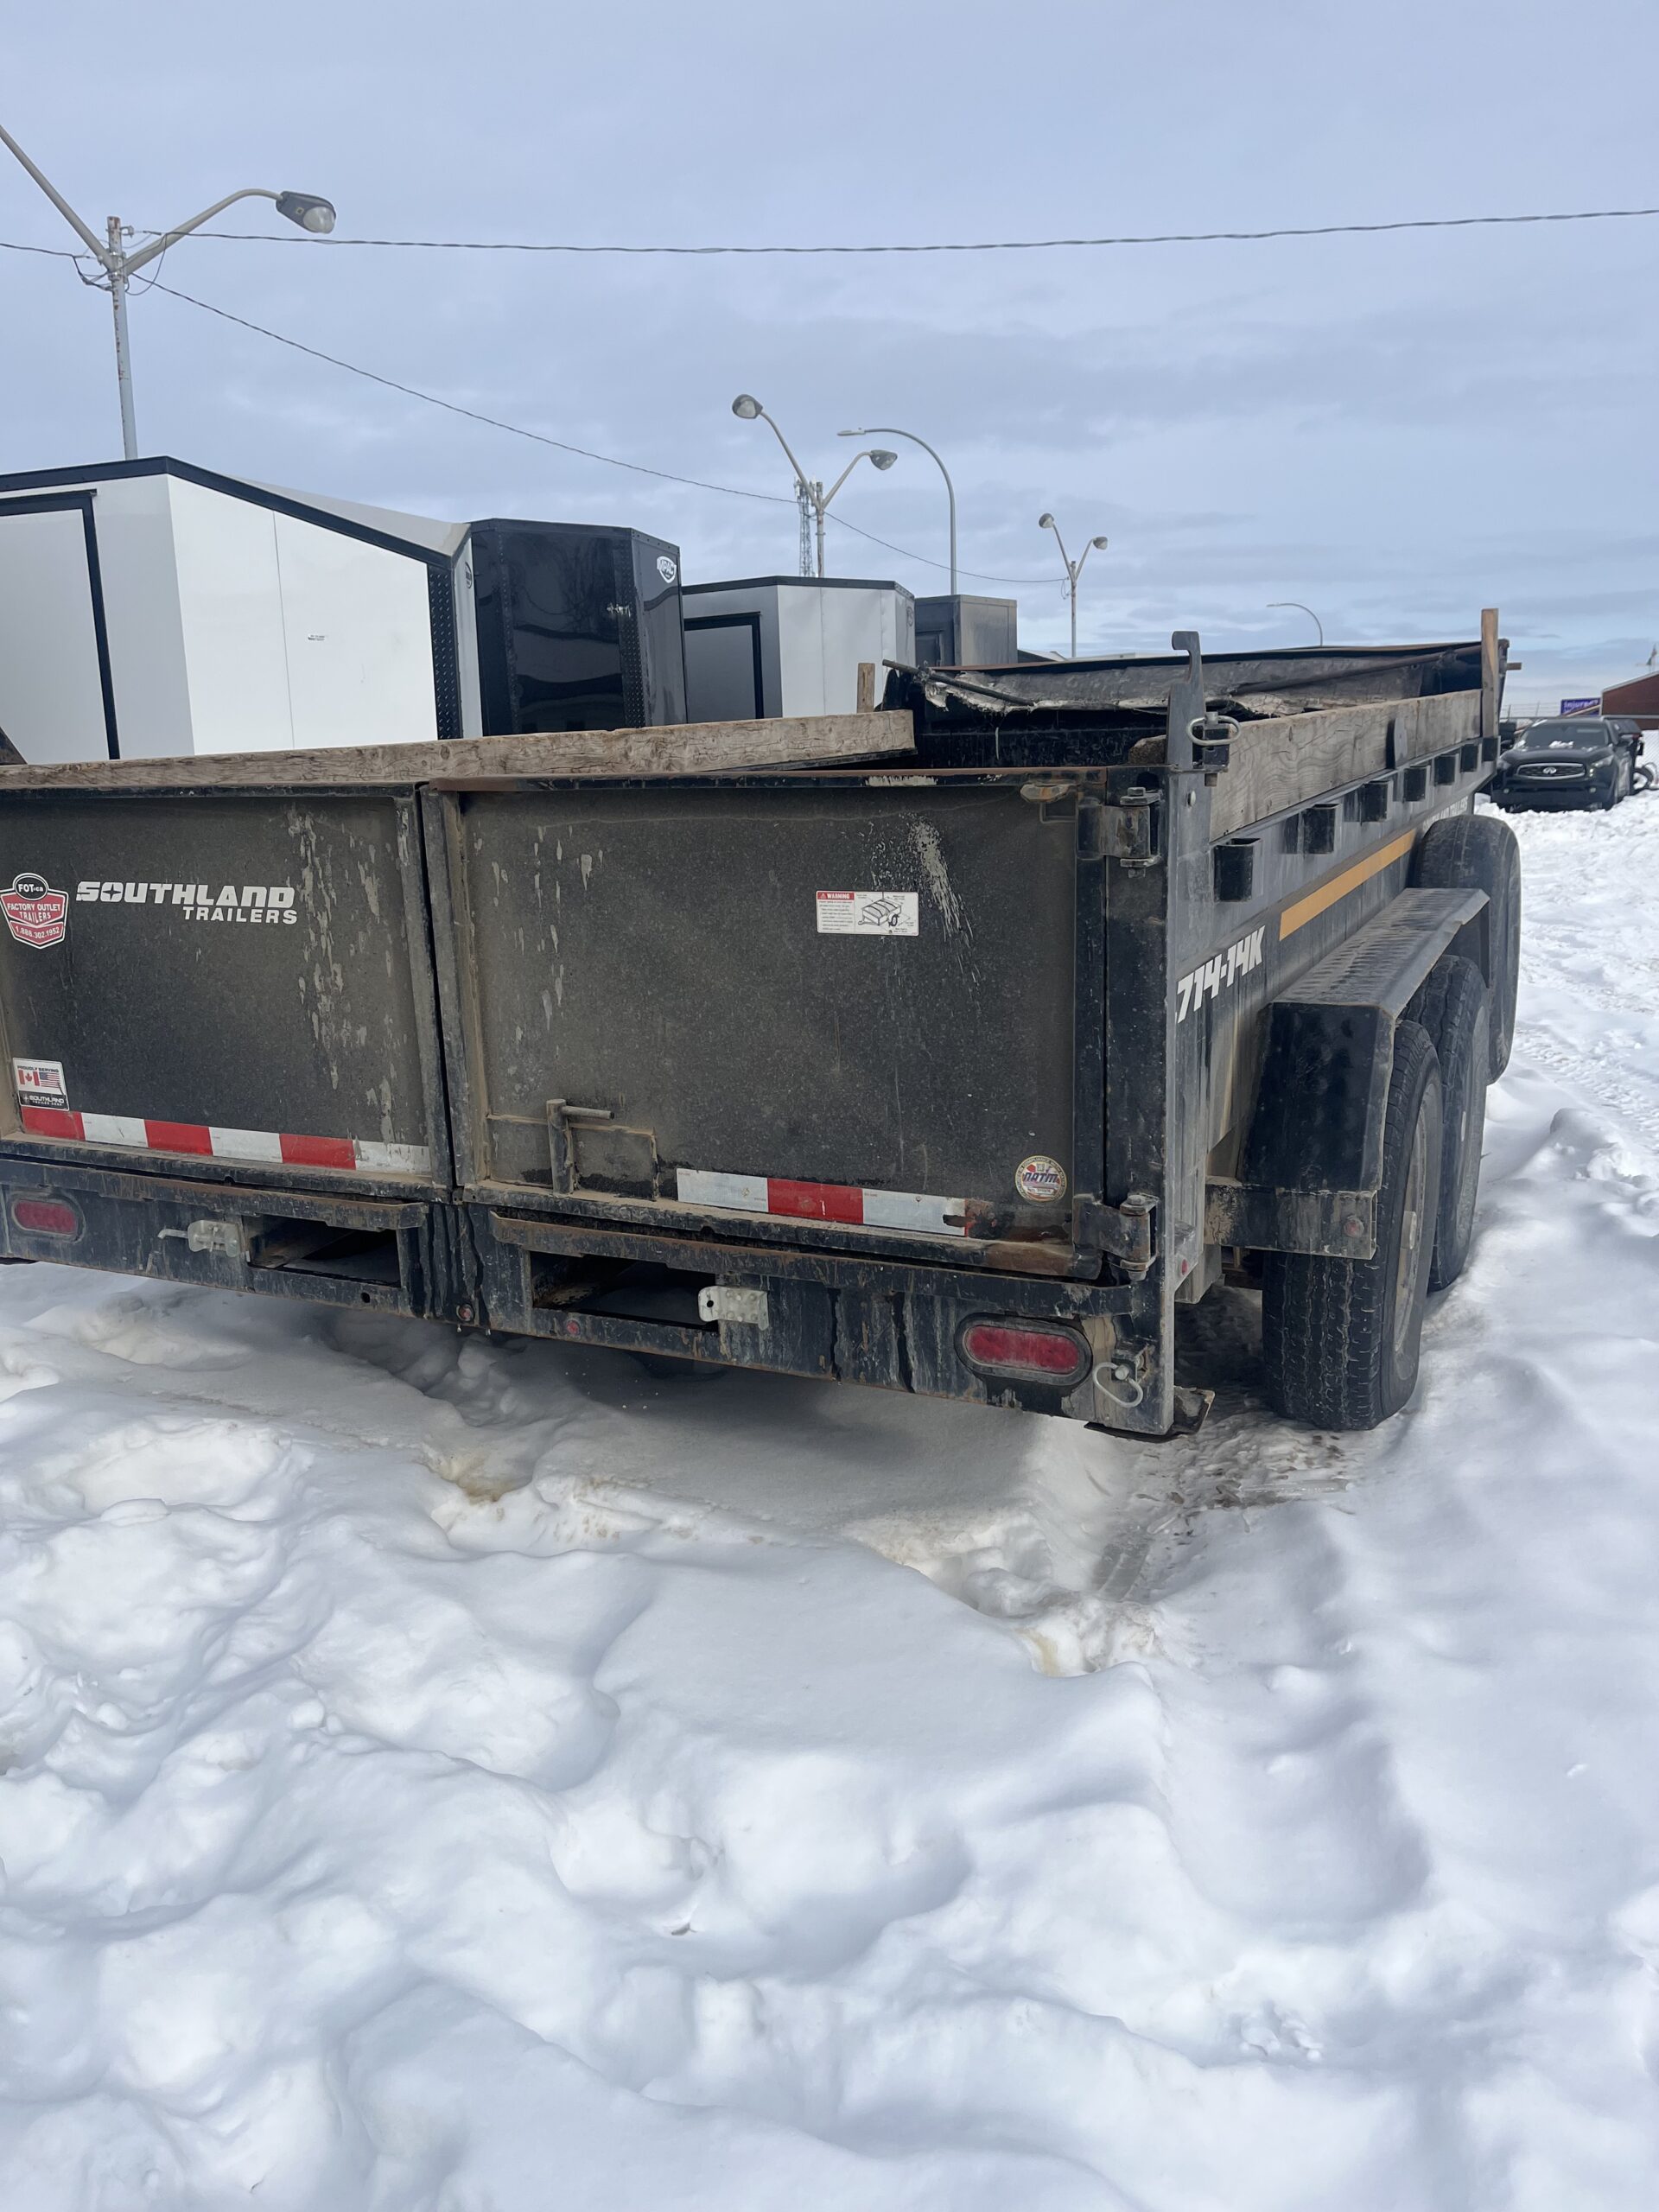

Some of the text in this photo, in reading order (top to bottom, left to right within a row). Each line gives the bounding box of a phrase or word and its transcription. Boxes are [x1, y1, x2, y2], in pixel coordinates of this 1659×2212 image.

[76, 880, 295, 908] SOUTHLAND
[19, 912, 51, 923] TRAILERS
[182, 906, 297, 925] TRAILERS
[1177, 925, 1266, 1024] 714-14K
